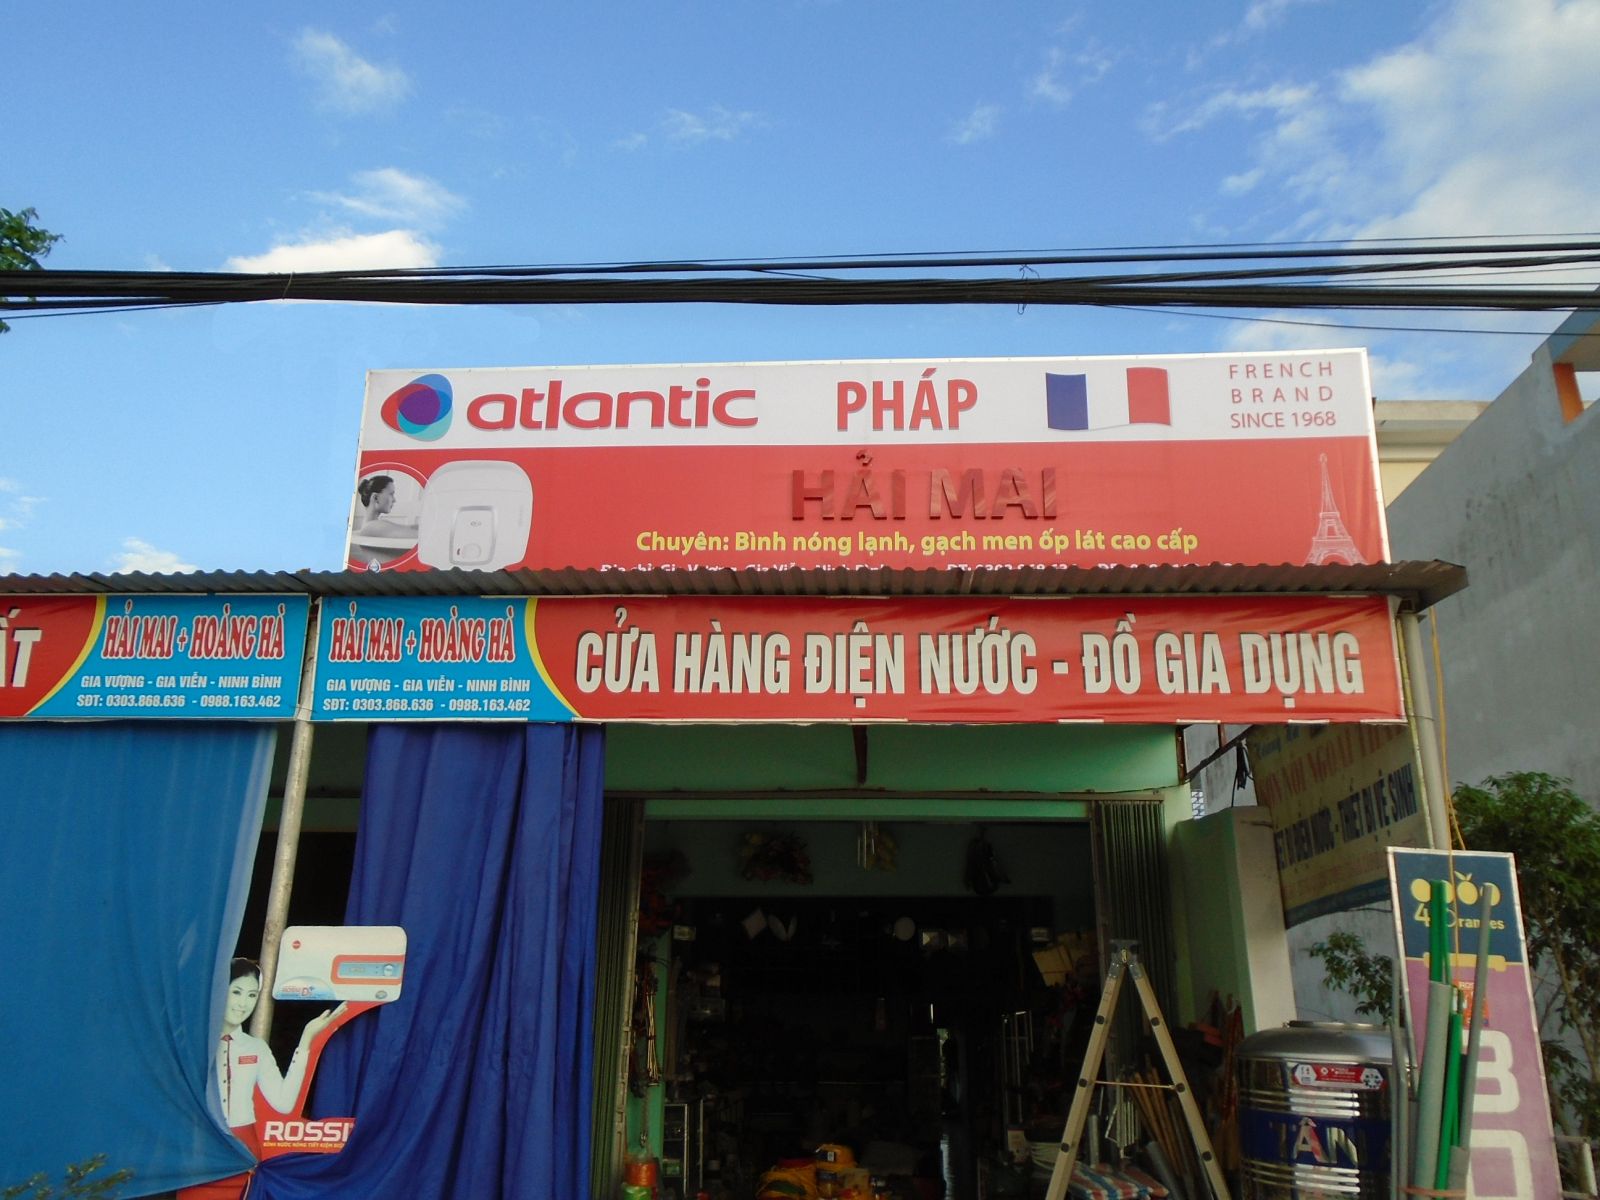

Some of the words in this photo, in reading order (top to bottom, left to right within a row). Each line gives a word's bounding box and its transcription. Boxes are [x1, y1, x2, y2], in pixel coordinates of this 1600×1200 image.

[1229, 361, 1332, 379] FRENCH
[467, 377, 758, 431] atlantic
[836, 367, 978, 431] PHÁP
[1231, 386, 1333, 404] BRAND
[1230, 412, 1285, 429] SINCE
[1291, 411, 1336, 427] 1968
[792, 450, 906, 520] HẢI
[929, 467, 1057, 520] MAI
[636, 531, 729, 555] Chuyên:
[735, 531, 786, 551] Bình
[793, 532, 852, 557] nóng
[858, 531, 915, 556] lạnh,
[921, 531, 976, 555] gạch
[982, 535, 1033, 550] men
[1039, 528, 1070, 555] ốp
[1076, 529, 1105, 549] lát
[1111, 534, 1151, 550] cao
[1157, 528, 1198, 554] cấp
[137, 615, 178, 660] MAI
[365, 617, 405, 663] MAI
[576, 606, 660, 693] CỬA
[674, 621, 790, 694] HÀNG
[804, 621, 905, 708] ĐIỆN
[920, 615, 1038, 695] NƯỚC
[1081, 612, 1141, 695] ĐỒ
[1155, 632, 1231, 695] GIA
[1240, 632, 1365, 708] DỤNG
[81, 675, 101, 688] GIA
[105, 674, 145, 691] VƯỢNG
[155, 675, 176, 688] GIA
[218, 676, 249, 688] NINH
[326, 679, 346, 692] GIA
[350, 678, 391, 694] VƯỢNG
[402, 679, 423, 692] GIA
[466, 679, 497, 692] NINH
[76, 694, 103, 707] SĐT:
[106, 694, 185, 707] 0303.868.636
[200, 695, 281, 708] 0988.163.462
[323, 698, 349, 711] SĐT:
[352, 698, 433, 711] 0303.868.636
[449, 699, 531, 711] 0988.163.462
[264, 1120, 350, 1142] ROSSI
